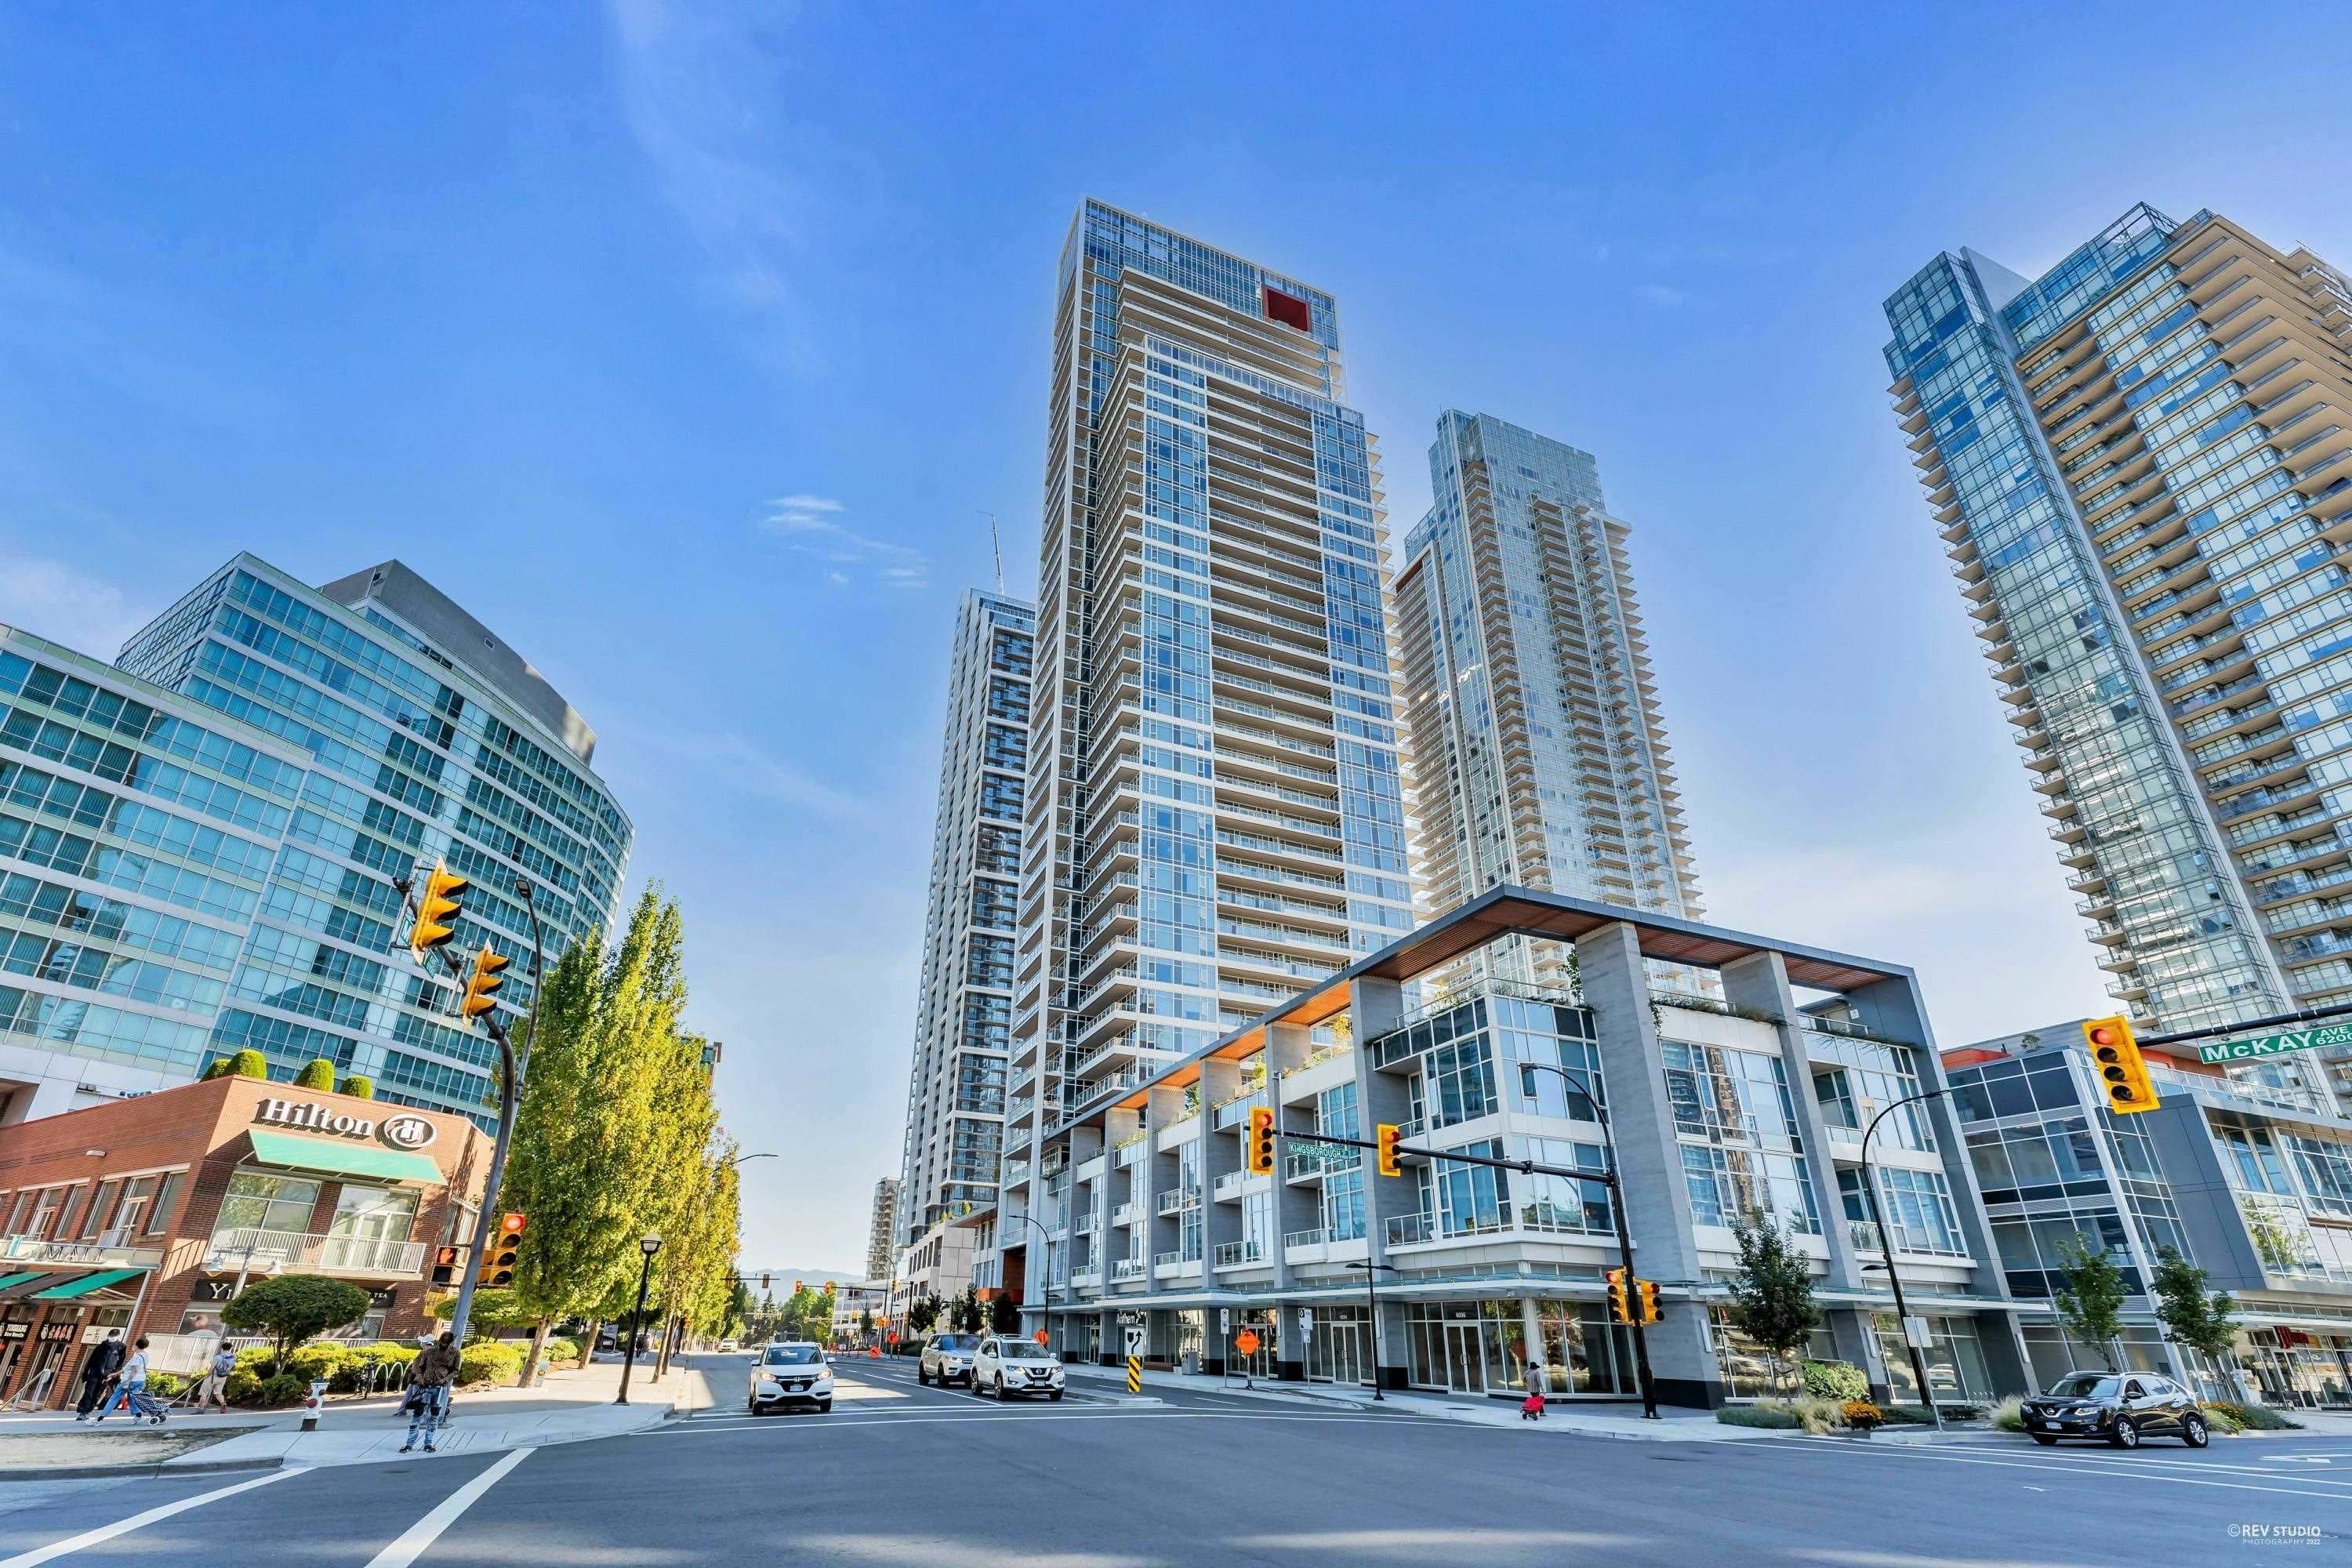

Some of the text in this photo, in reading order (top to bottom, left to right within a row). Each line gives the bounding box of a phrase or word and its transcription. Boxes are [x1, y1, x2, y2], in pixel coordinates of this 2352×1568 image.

[2321, 1026, 2350, 1037] AVE
[261, 1098, 375, 1136] Hilton
[1290, 1144, 1341, 1158] KINGSBOROUGH
